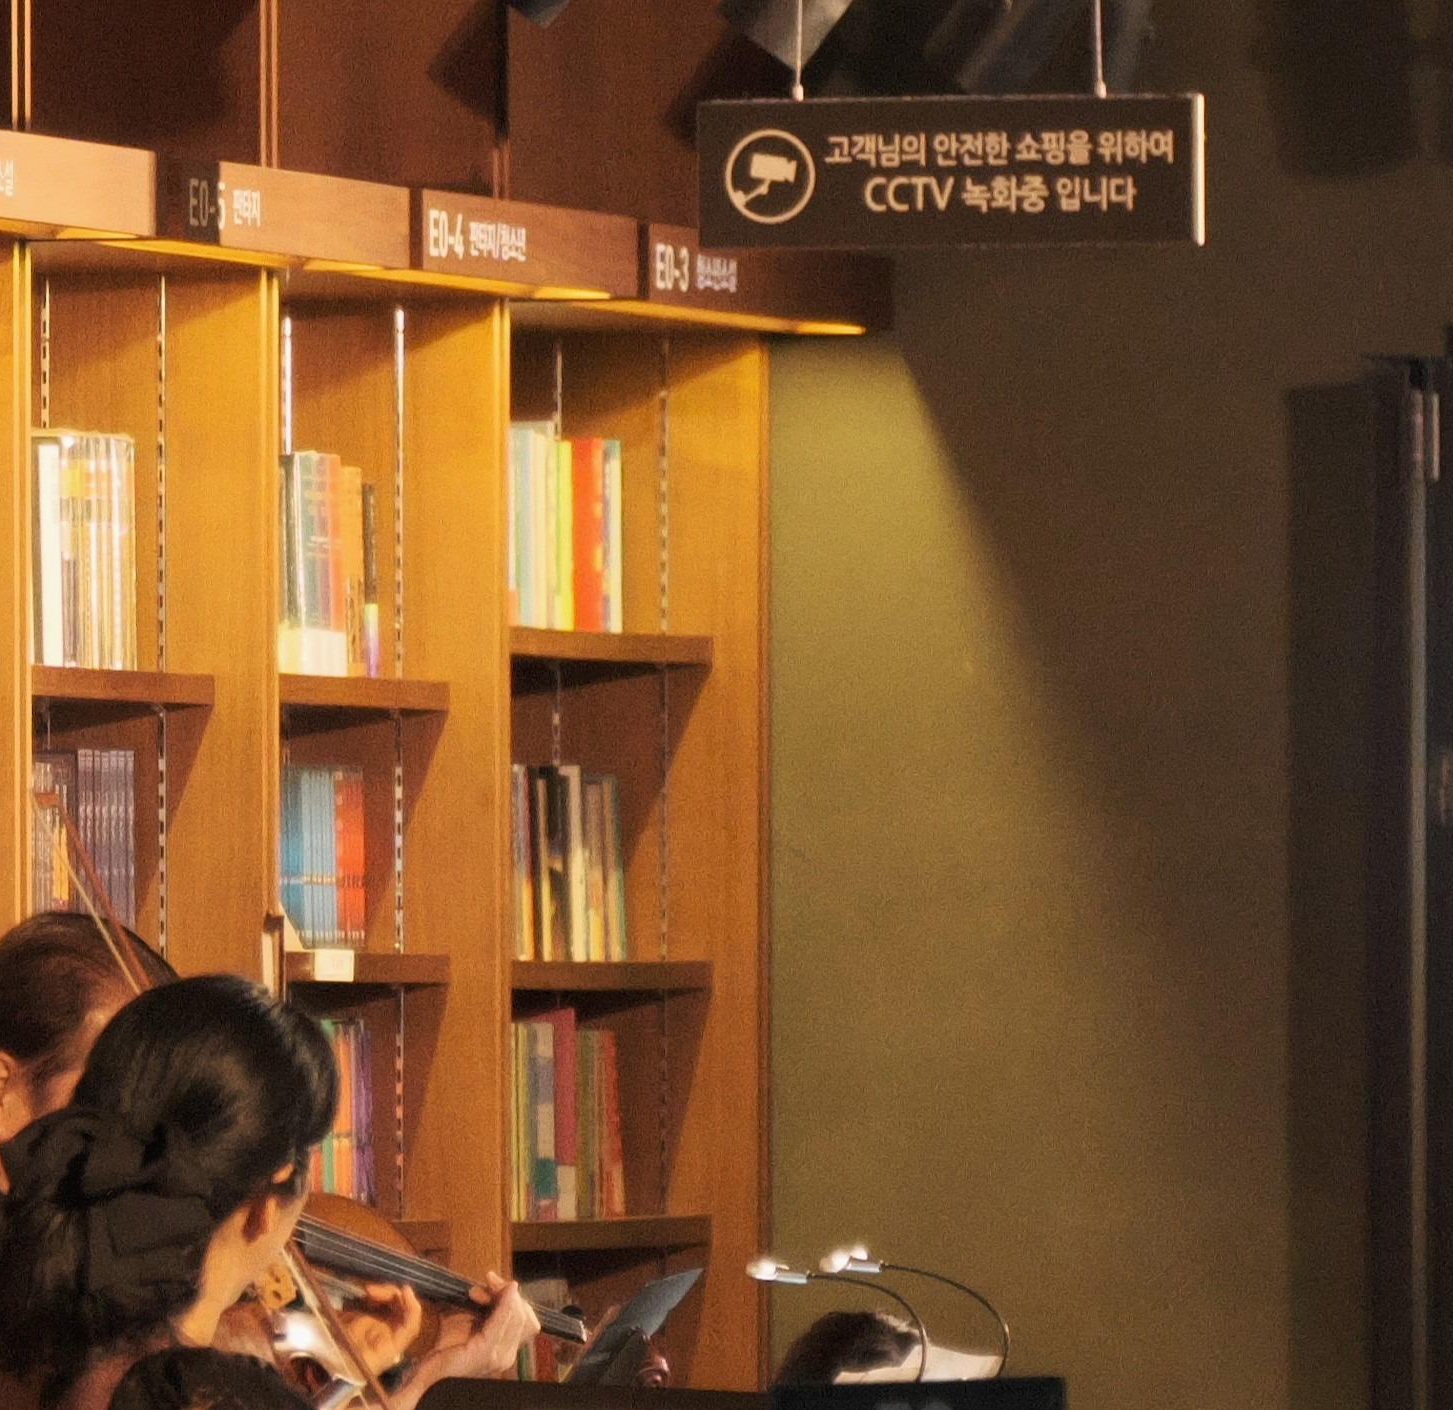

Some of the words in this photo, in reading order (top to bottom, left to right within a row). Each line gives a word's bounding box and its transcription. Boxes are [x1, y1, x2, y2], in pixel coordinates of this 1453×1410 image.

[824, 132, 927, 167] 고객님의
[933, 132, 1010, 167] 안전한
[1015, 130, 1092, 165] 쇼핑을
[1096, 128, 1175, 164] 위하여
[863, 176, 954, 213] CCTV
[961, 175, 1049, 214] 녹화중
[1055, 175, 1137, 212] 입니다
